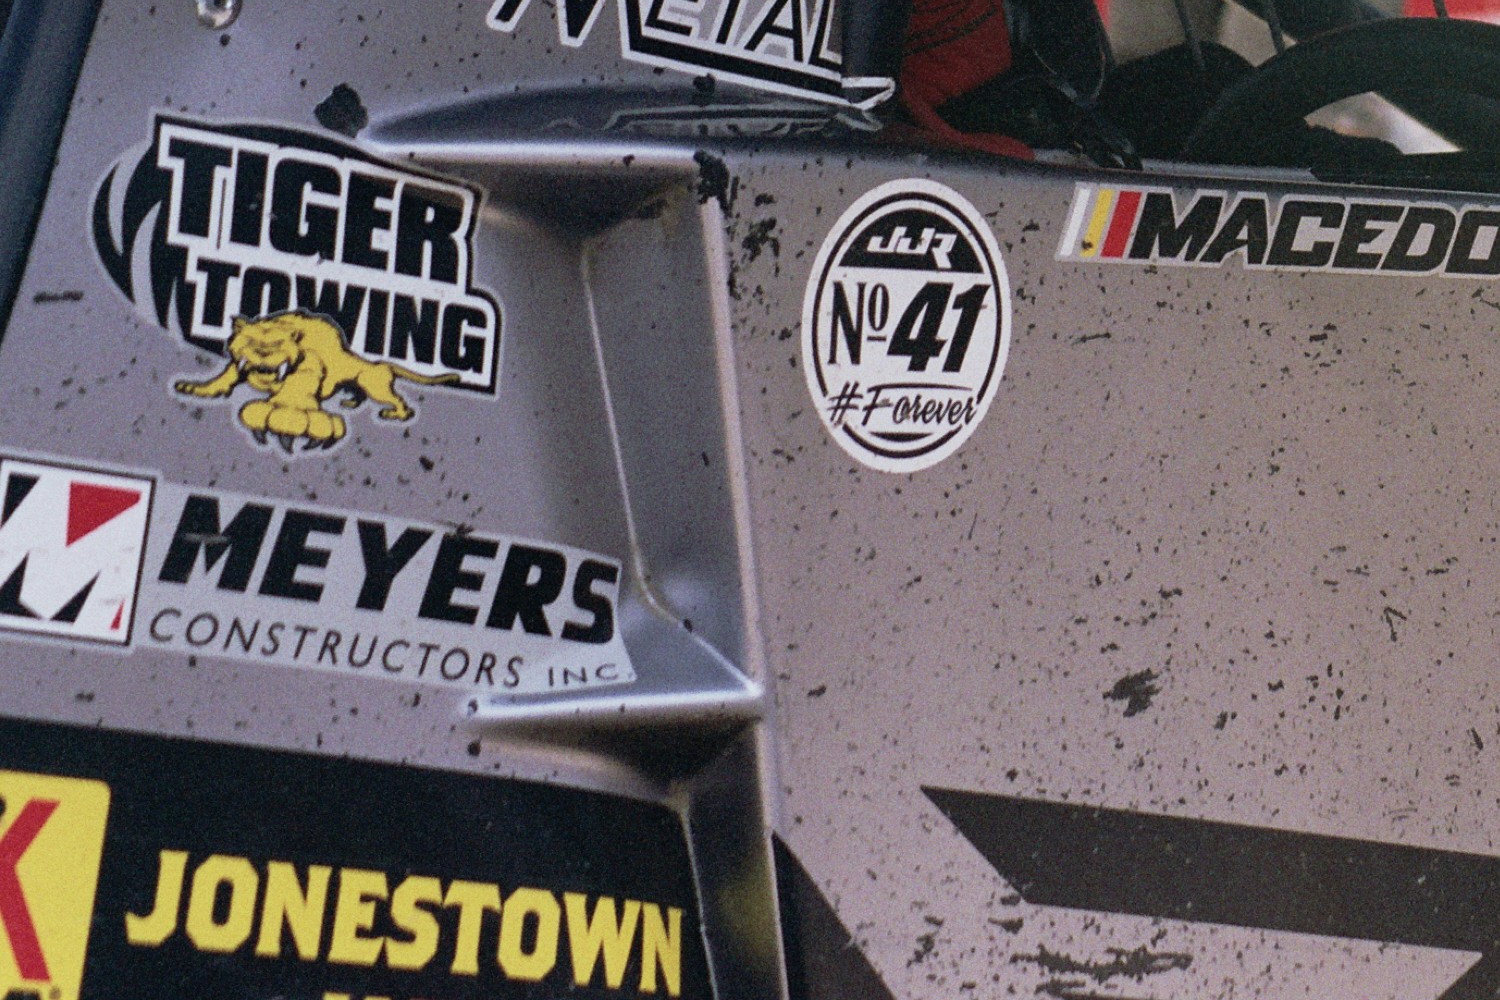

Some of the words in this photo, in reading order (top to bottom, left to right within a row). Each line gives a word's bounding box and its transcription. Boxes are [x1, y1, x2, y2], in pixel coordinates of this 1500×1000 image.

[168, 136, 467, 285] TIGER
[195, 255, 488, 374] TOWING
[886, 281, 991, 373] 41
[826, 380, 978, 427] #Forever
[158, 495, 620, 645] MEYERS
[149, 608, 524, 688] CONSTRUCTORS
[124, 848, 682, 997] JONESTOWN
